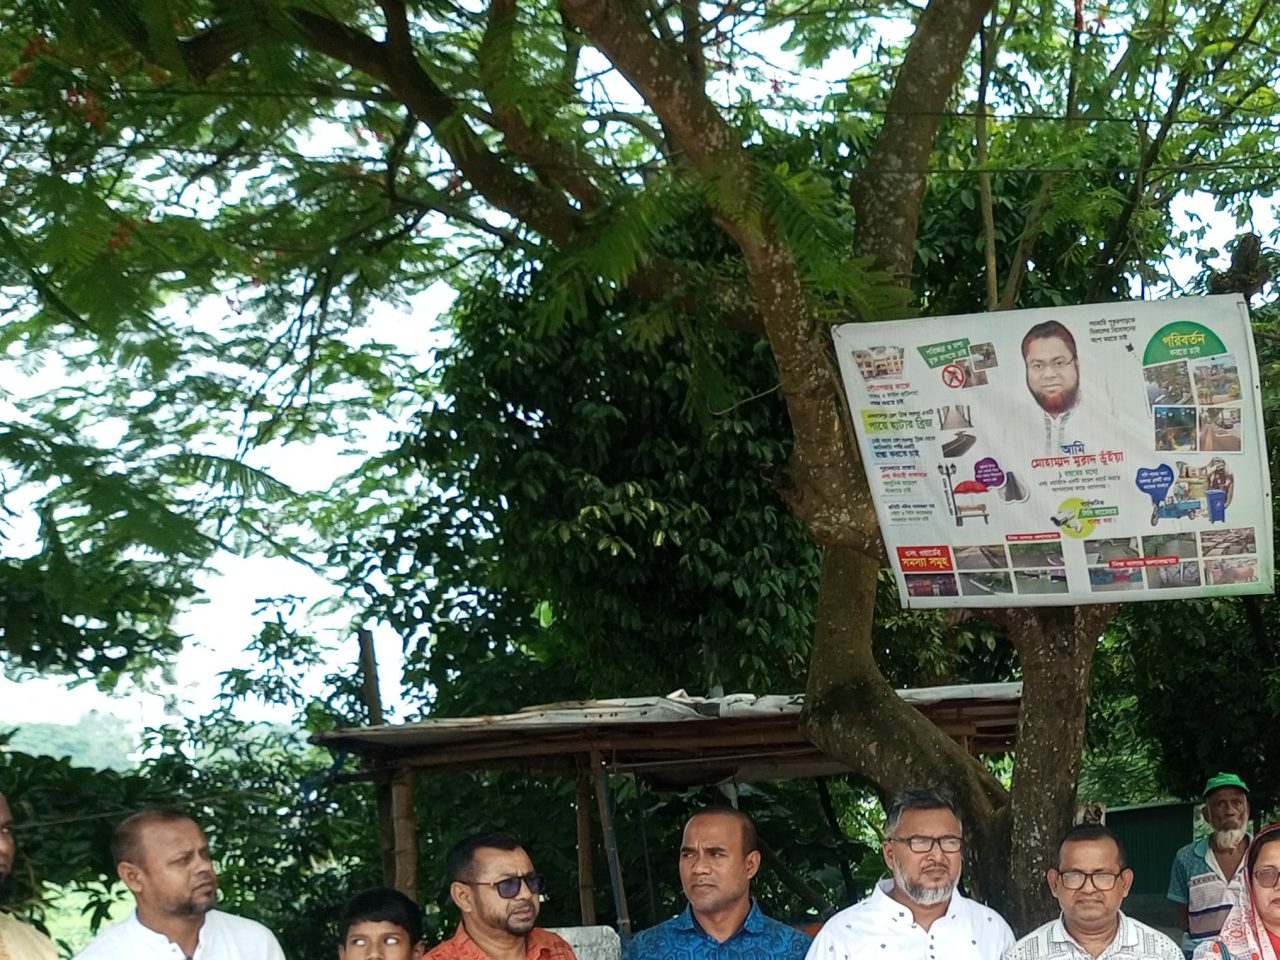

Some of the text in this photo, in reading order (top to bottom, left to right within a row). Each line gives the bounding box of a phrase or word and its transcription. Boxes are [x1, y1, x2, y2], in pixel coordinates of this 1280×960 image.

[1162, 330, 1206, 347] পরিবর্তন
[868, 421, 888, 431] পায়ে
[1060, 440, 1085, 455] আমি
[1073, 454, 1096, 467] মুরাদ
[901, 557, 949, 569] সমস্যা সমূহ
